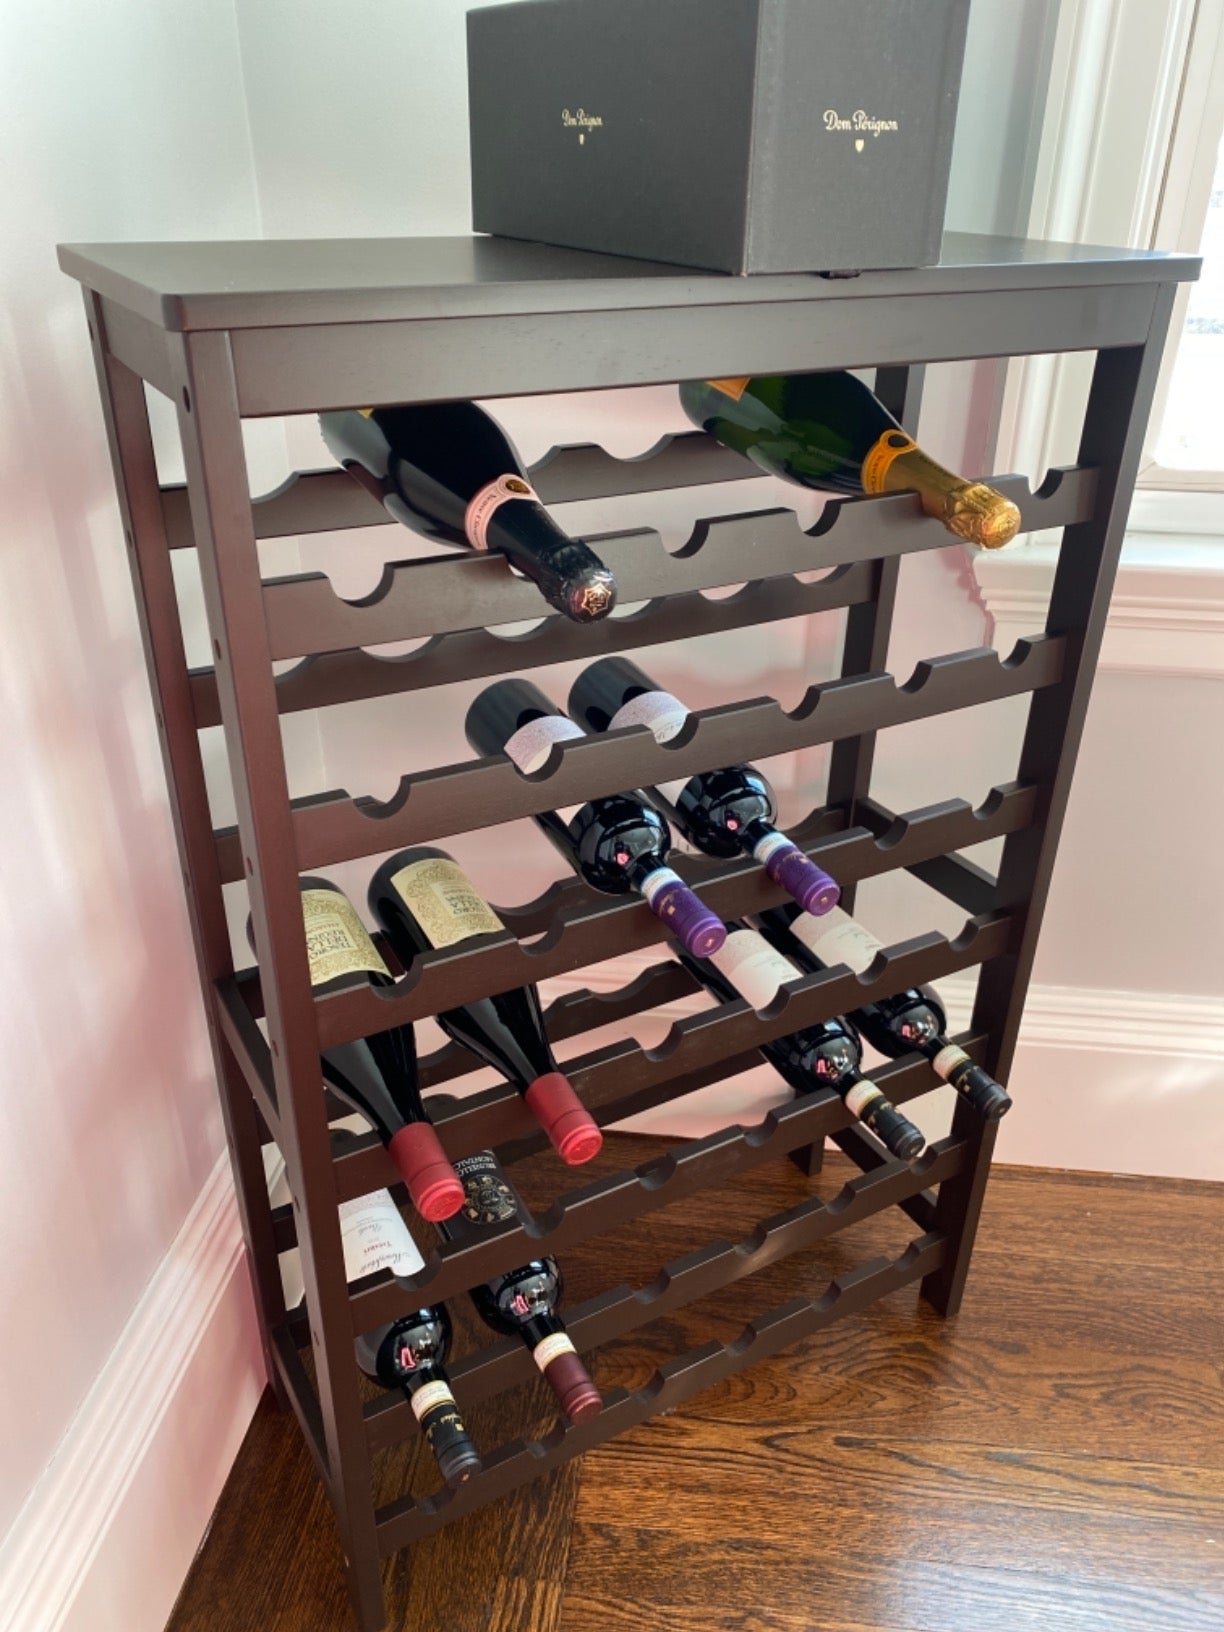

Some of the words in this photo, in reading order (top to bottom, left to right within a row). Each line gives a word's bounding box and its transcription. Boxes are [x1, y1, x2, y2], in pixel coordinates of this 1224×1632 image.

[562, 108, 577, 126] Dom
[823, 109, 851, 131] Dom
[852, 109, 898, 138] Pérignon
